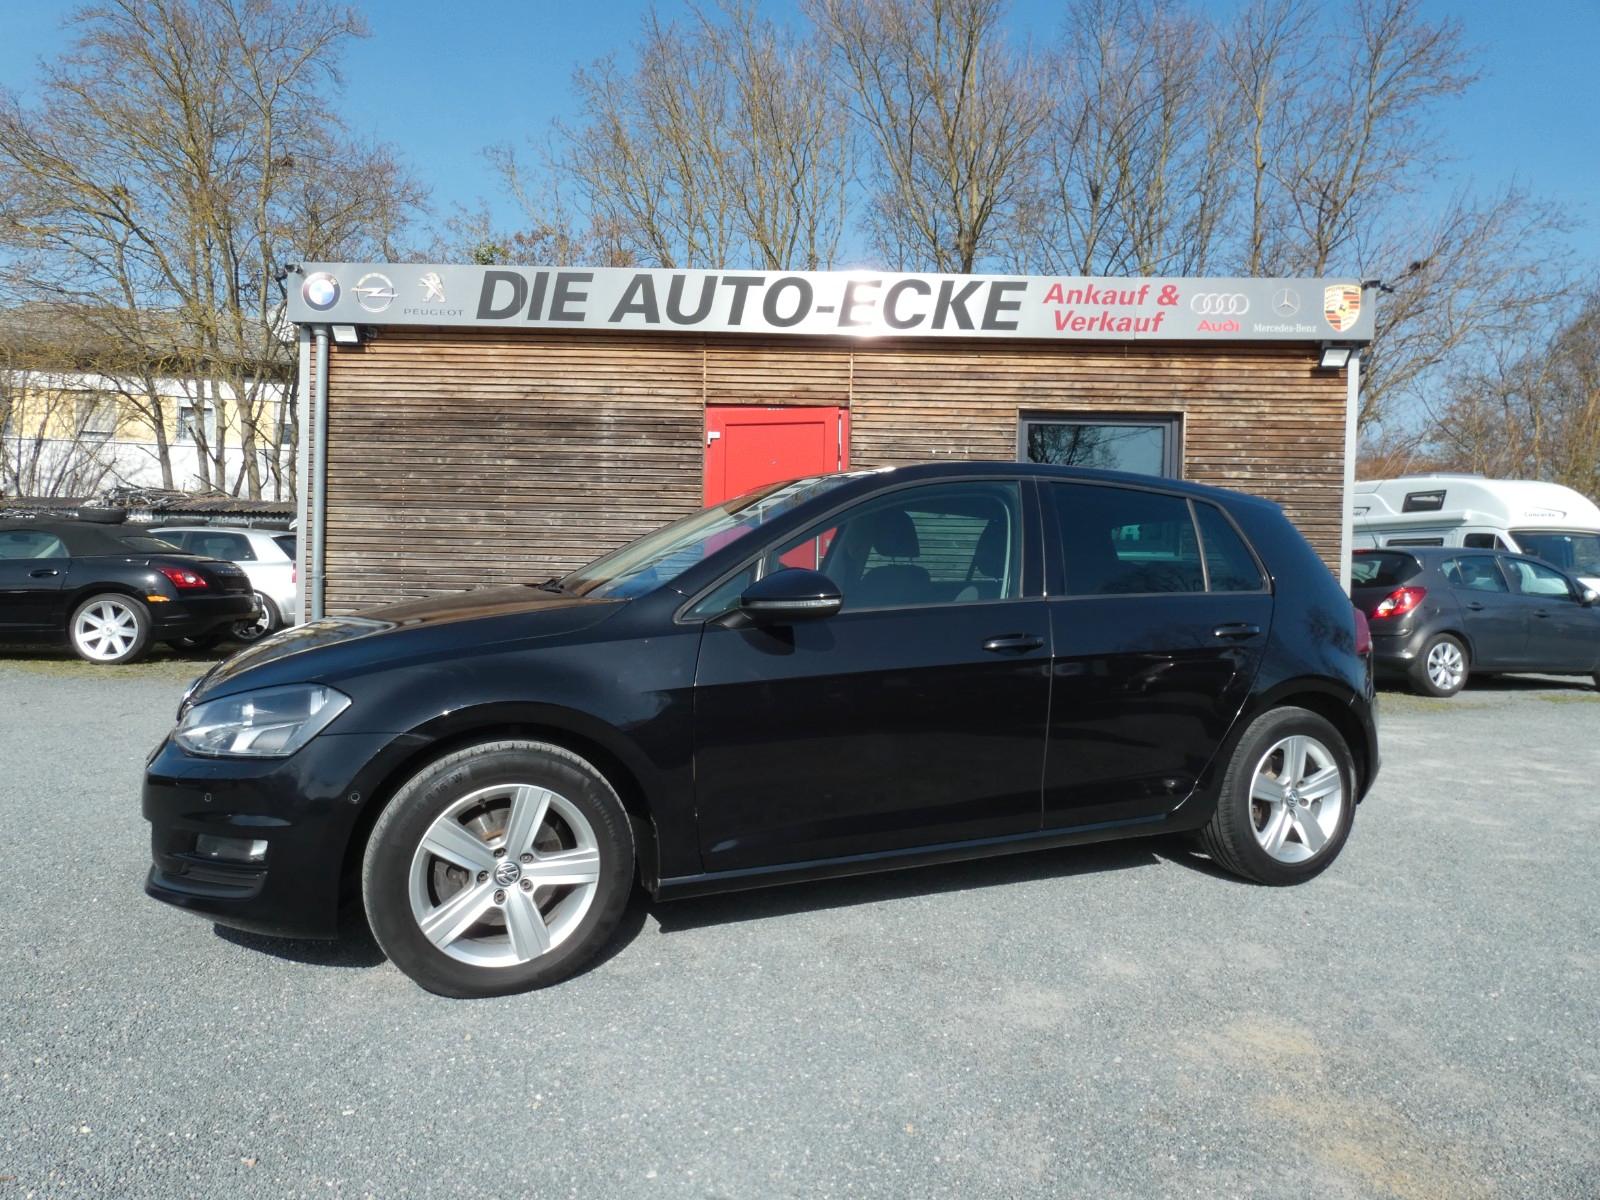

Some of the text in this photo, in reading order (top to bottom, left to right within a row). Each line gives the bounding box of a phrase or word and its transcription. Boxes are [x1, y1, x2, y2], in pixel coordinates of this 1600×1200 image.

[476, 270, 1028, 331] DIE AUTO-ECKE
[1042, 283, 1180, 306] Ankauf &
[403, 308, 463, 317] PEUGEOT
[1053, 310, 1165, 333] Verkauf
[1196, 319, 1240, 333] Audi
[1253, 323, 1317, 333] Mercedes-Benz
